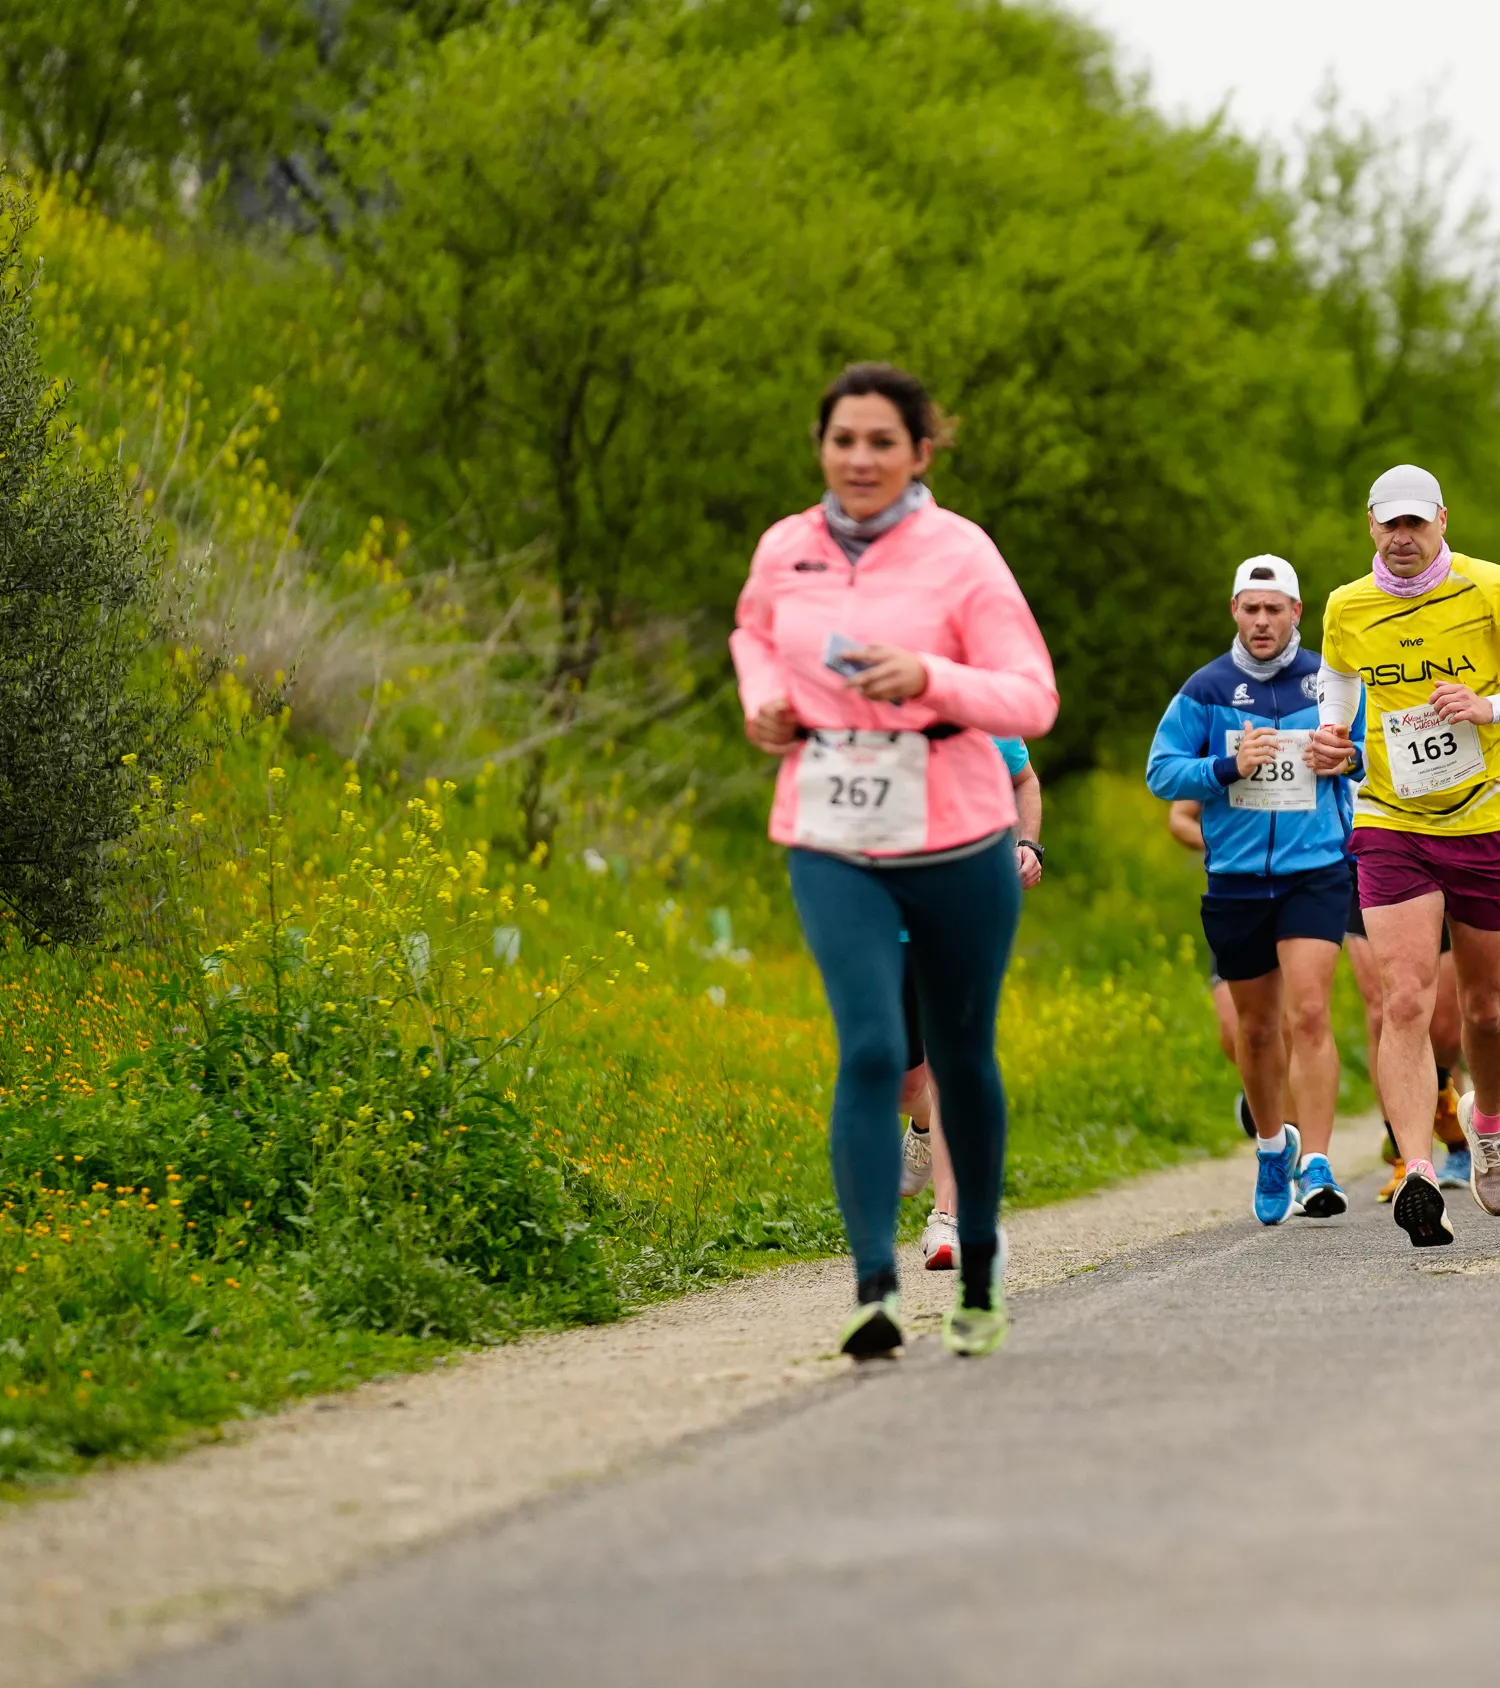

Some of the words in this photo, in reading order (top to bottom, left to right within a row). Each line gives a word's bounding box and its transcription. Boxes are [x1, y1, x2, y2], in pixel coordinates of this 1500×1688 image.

[1400, 637, 1424, 648] vive
[1413, 718, 1442, 731] LUCENA
[1407, 732, 1458, 765] 163
[1250, 760, 1296, 782] 238
[828, 776, 891, 809] 267
